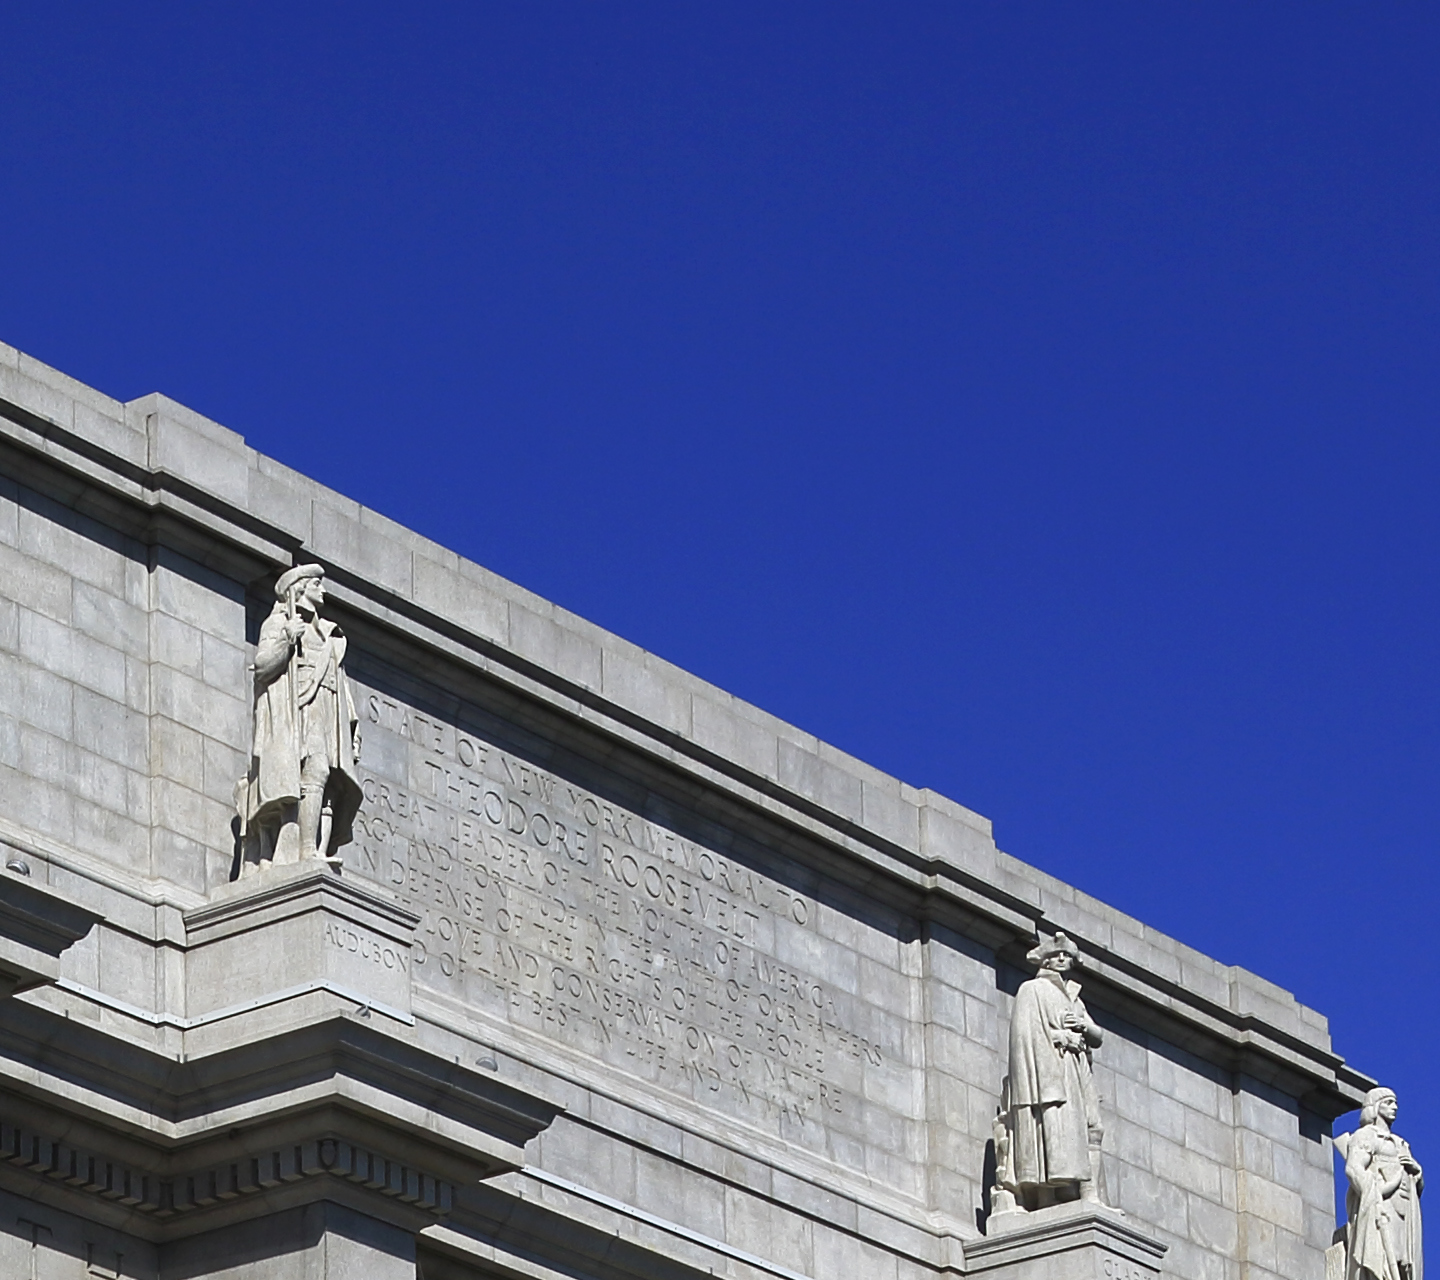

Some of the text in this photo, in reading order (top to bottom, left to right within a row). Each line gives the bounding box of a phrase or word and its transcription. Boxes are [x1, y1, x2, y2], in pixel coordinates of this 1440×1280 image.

[358, 809, 399, 842] RGY
[362, 778, 438, 830] GREAT
[449, 816, 534, 877] LEADER
[580, 876, 620, 915] THE
[632, 900, 703, 951] YOUTH
[750, 952, 838, 1016] AMERICA
[369, 695, 808, 926] STATE OF NEW YORK MEMORIAL TO
[424, 760, 760, 944] THEODORE ROOSEVELT
[324, 922, 409, 972] AUDUBON
